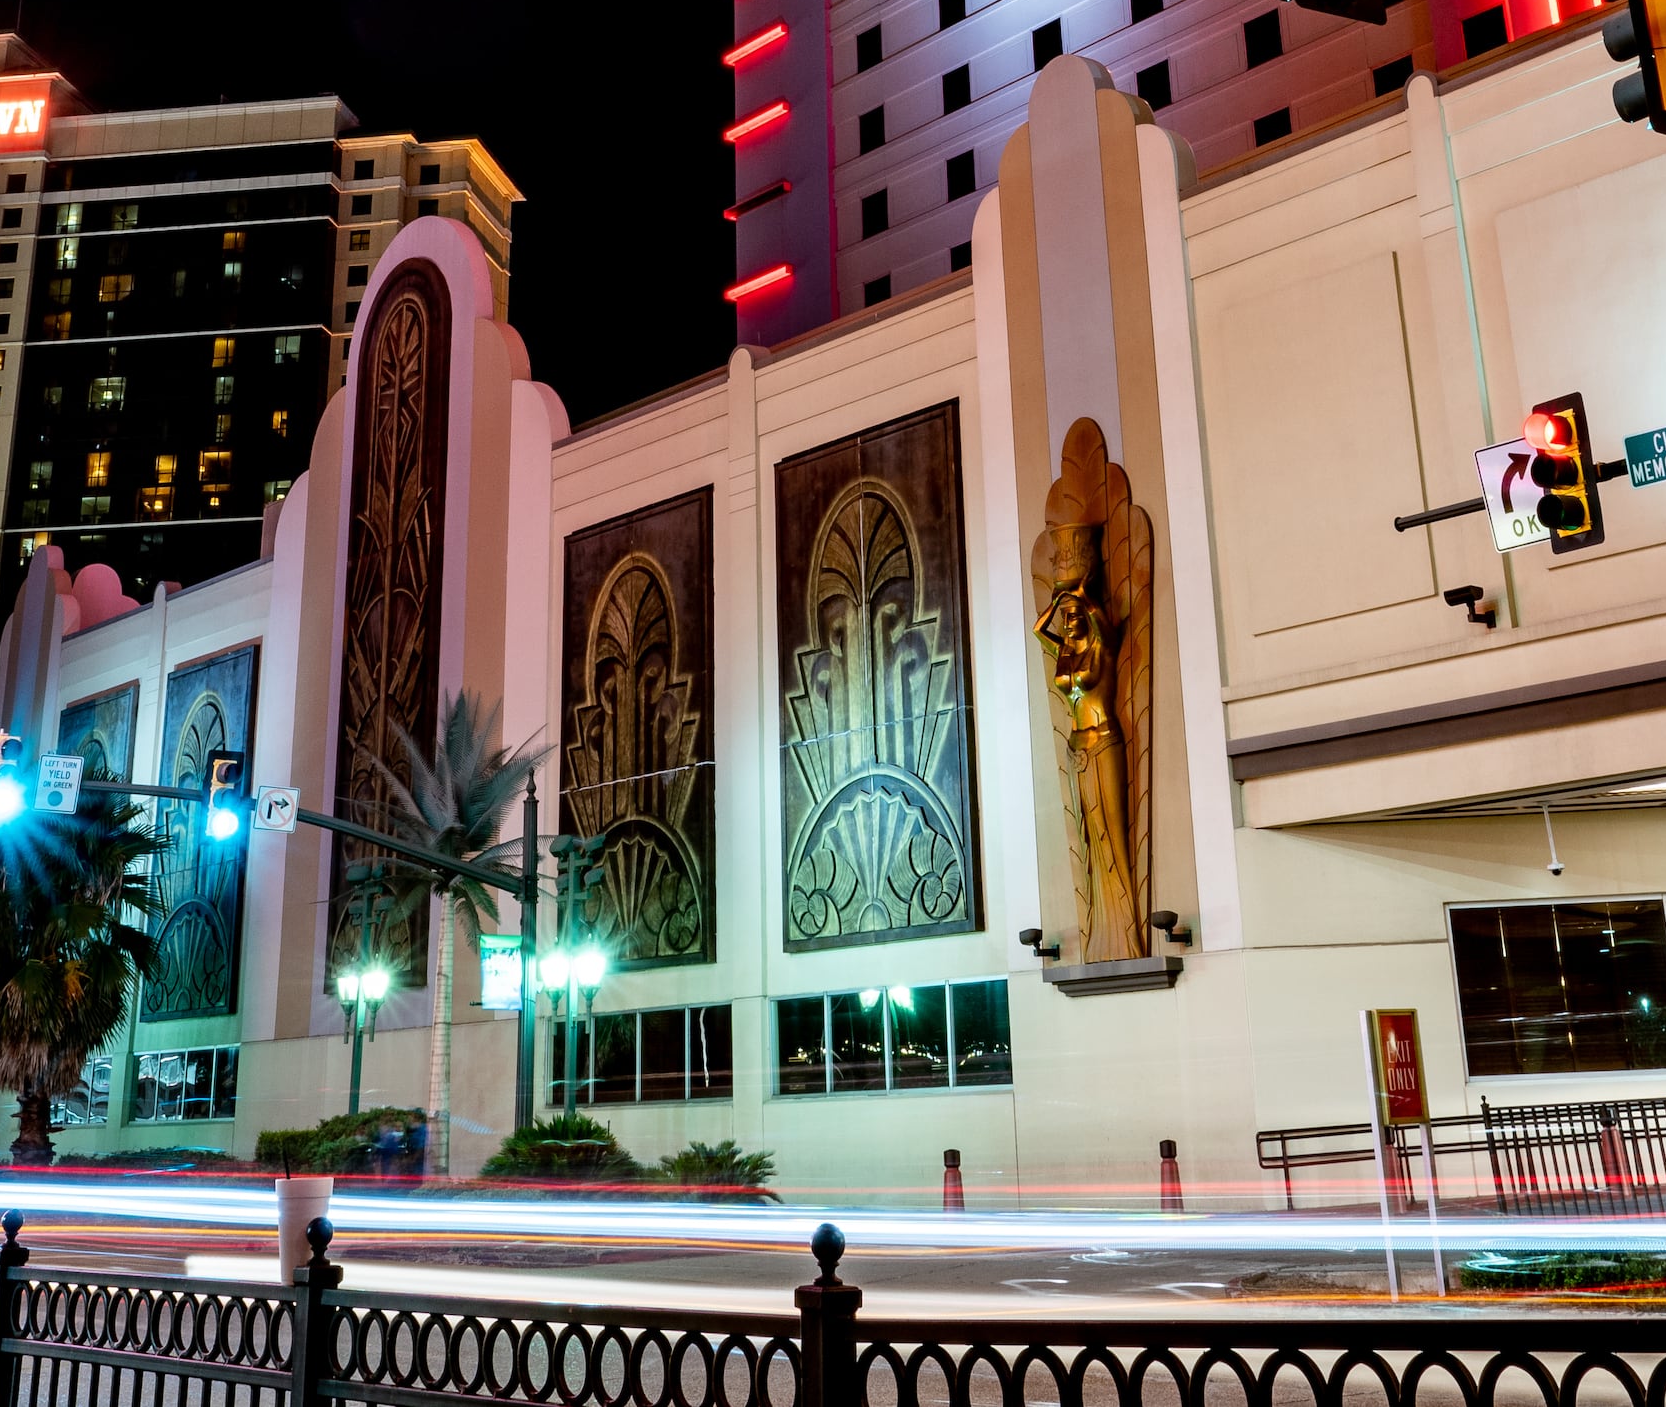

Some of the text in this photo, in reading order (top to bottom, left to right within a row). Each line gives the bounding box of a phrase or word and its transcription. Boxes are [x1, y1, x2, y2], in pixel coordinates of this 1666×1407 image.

[49, 770, 71, 779] YIELD
[1386, 1040, 1411, 1063] EXIT
[1387, 1067, 1416, 1092] ONLY
